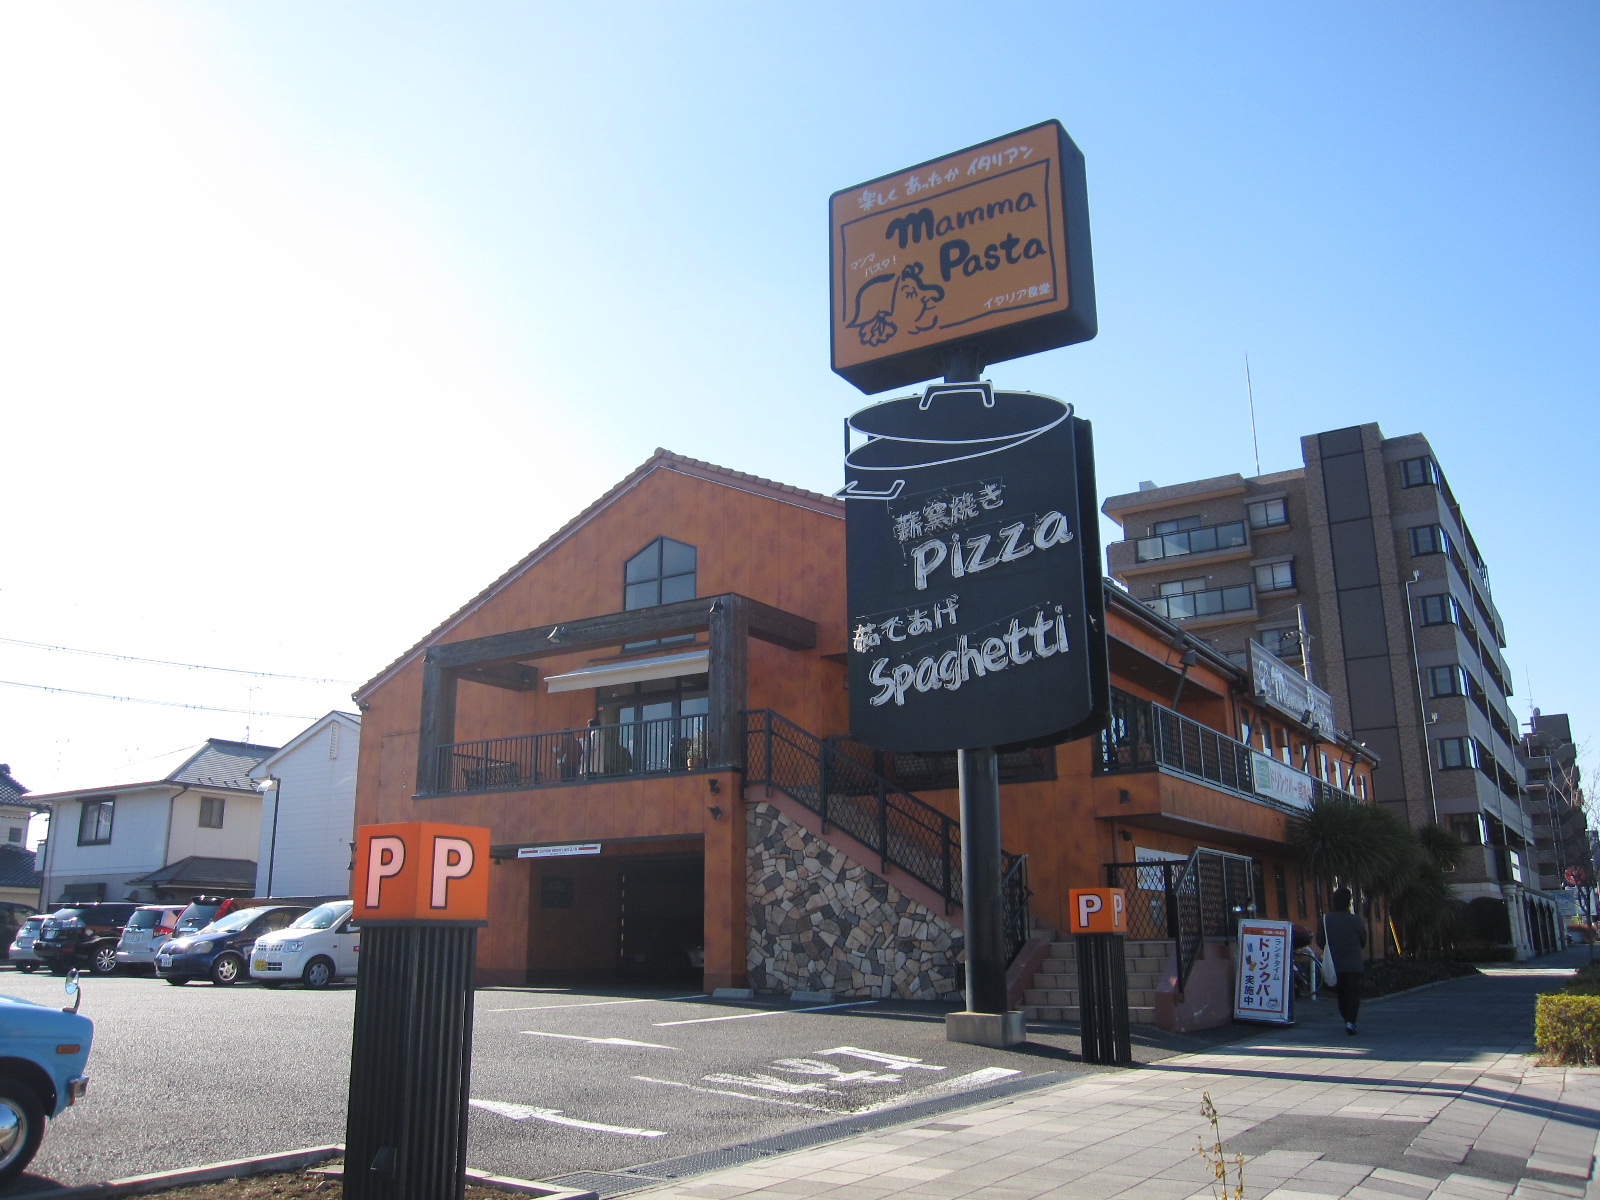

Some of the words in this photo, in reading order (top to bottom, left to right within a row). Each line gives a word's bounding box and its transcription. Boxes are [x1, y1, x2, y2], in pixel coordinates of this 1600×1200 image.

[857, 188, 898, 212] 楽しく
[905, 168, 960, 196] あったか
[967, 145, 1035, 177] イタリアン
[850, 252, 876, 271] マンマ
[939, 232, 1047, 282] Pasta
[910, 510, 1074, 590] Pizza
[869, 604, 1069, 706] Spaghetti
[365, 834, 406, 910] P
[430, 834, 475, 910] P
[1077, 893, 1103, 928] P
[1113, 893, 1123, 927] P
[1255, 937, 1271, 1007] ドリンクバー
[1272, 938, 1282, 981] ランチタイム
[1243, 974, 1255, 1006] 実施中
